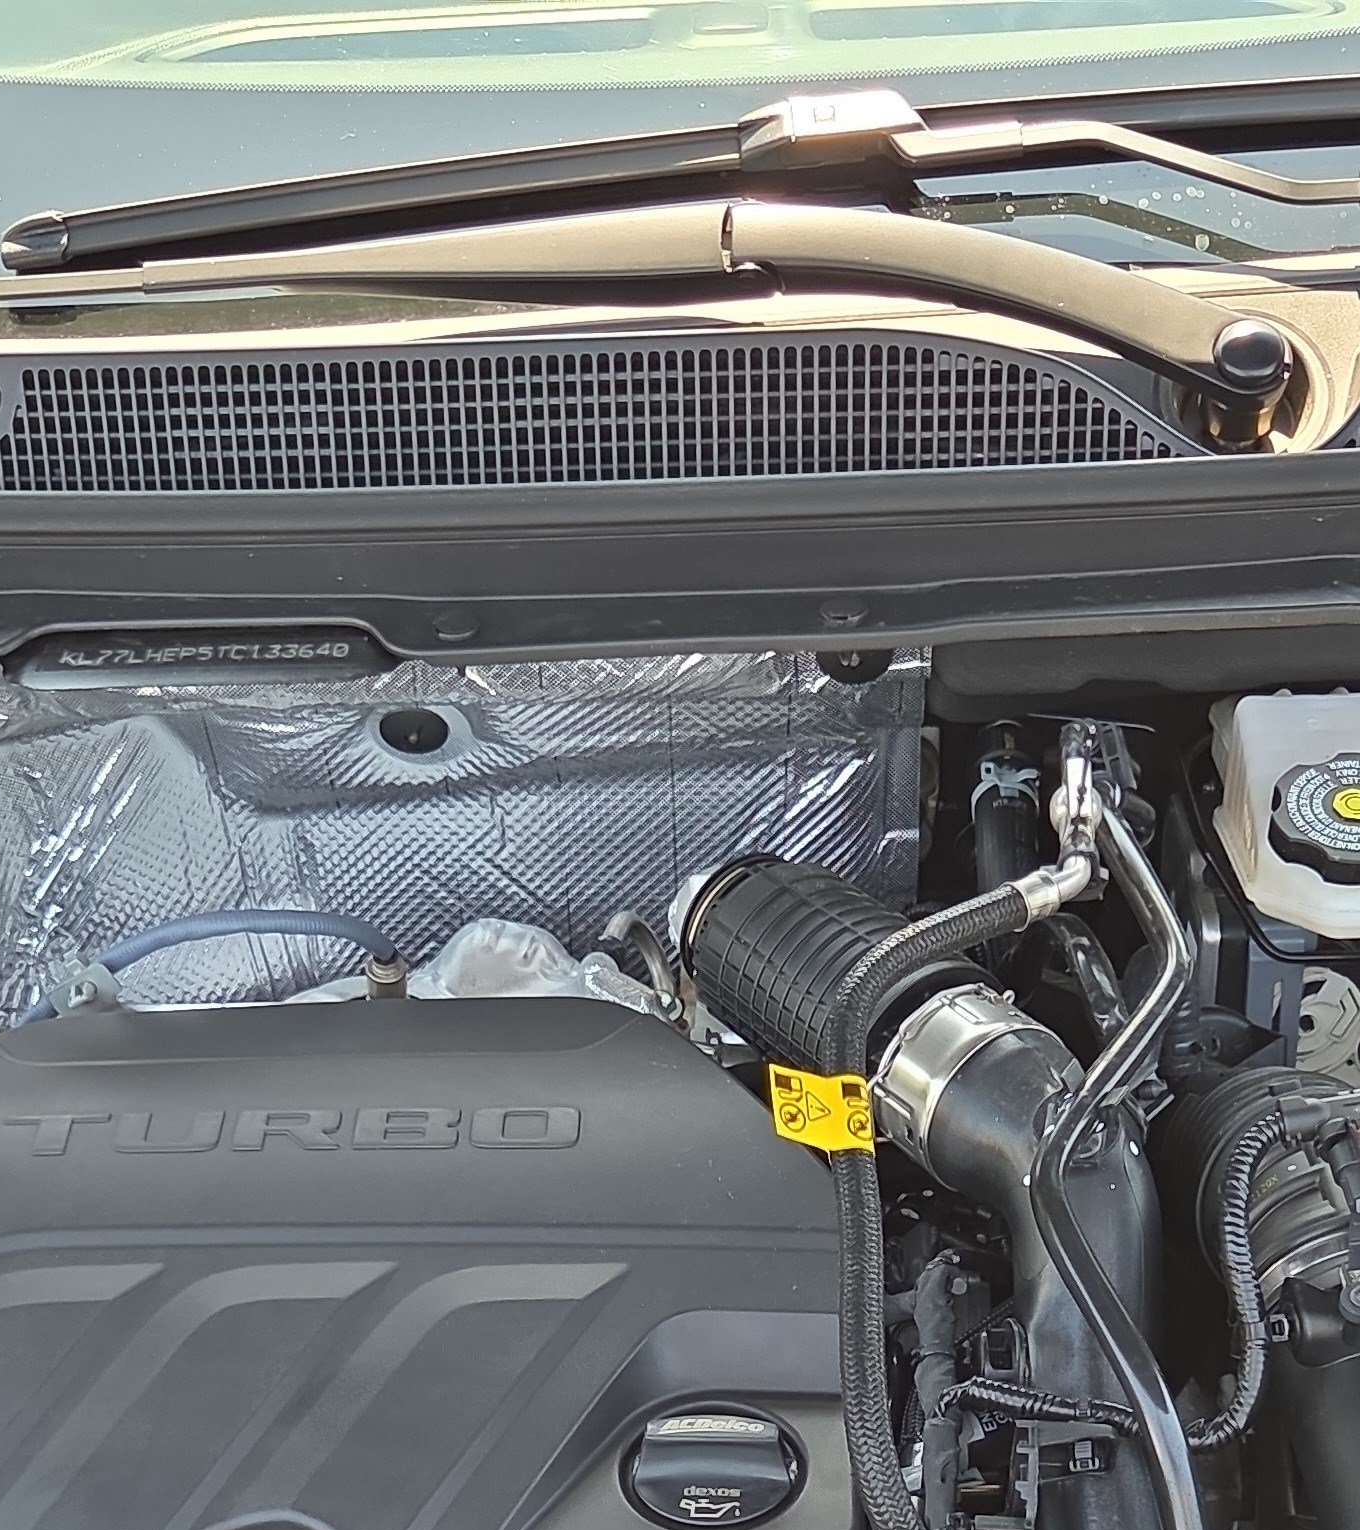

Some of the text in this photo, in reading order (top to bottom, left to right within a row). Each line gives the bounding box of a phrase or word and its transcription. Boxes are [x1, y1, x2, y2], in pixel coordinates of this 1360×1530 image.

[59, 643, 351, 667] KL77LHEP5TC133640
[2, 1106, 583, 1157] TURBO
[659, 1419, 765, 1433] ACDelco
[683, 1485, 742, 1497] dexos
